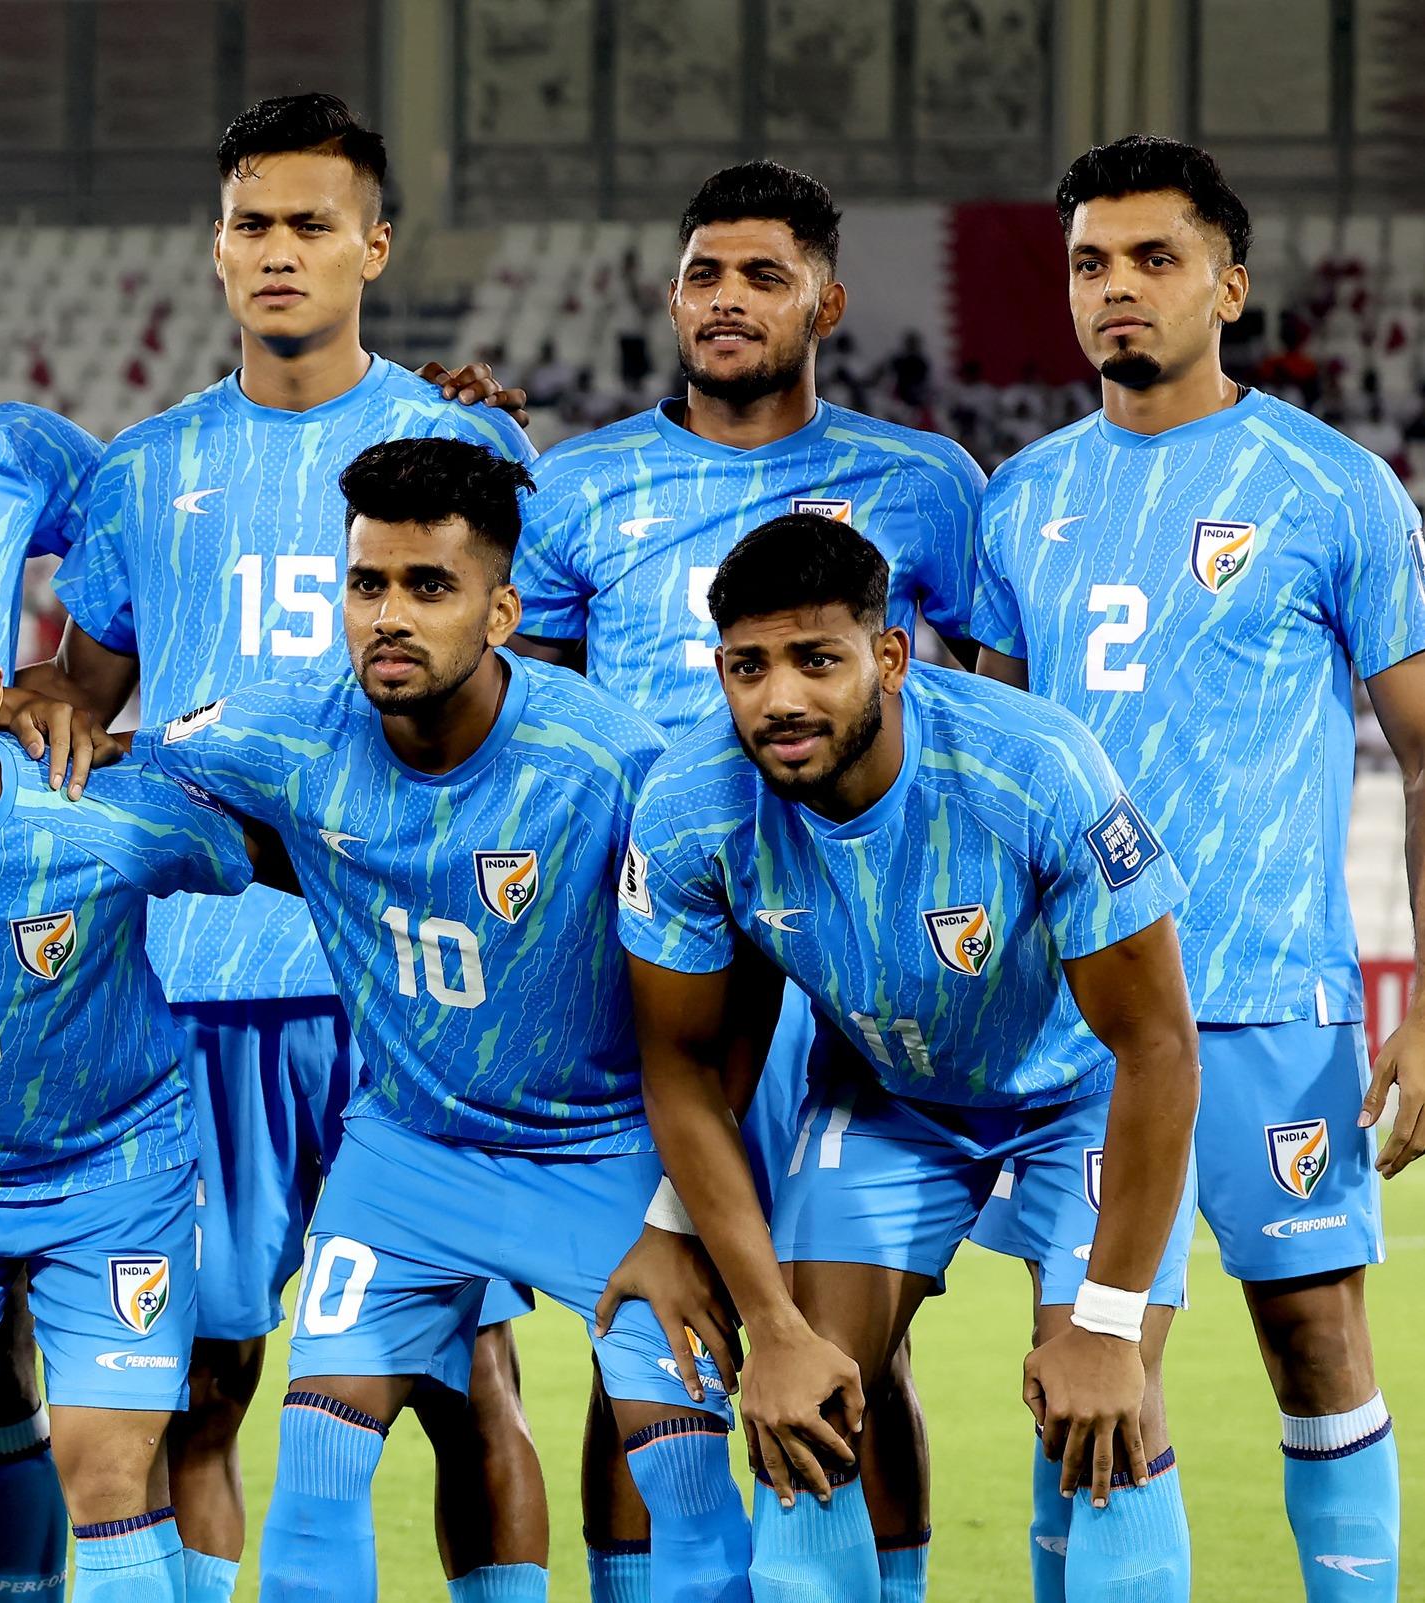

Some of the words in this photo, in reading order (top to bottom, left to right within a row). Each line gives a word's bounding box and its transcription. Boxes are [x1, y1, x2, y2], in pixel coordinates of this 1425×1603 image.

[802, 507, 832, 516] INDIA
[1203, 529, 1234, 539] INDIA
[232, 555, 336, 657] 15
[1086, 584, 1149, 692] 2
[1105, 819, 1133, 853] UNITES
[485, 858, 518, 869] INDIA
[22, 921, 56, 933] INDIA
[936, 915, 969, 927] INDIA
[380, 906, 487, 1009] 10
[850, 1011, 935, 1077] 11
[786, 1106, 849, 1171] 11
[1277, 1131, 1308, 1143] INDIA
[1290, 1214, 1347, 1233] PERFORMAX
[119, 1266, 150, 1276] INDIA
[293, 1235, 378, 1335] 10
[125, 1355, 178, 1369] PERFORMAX
